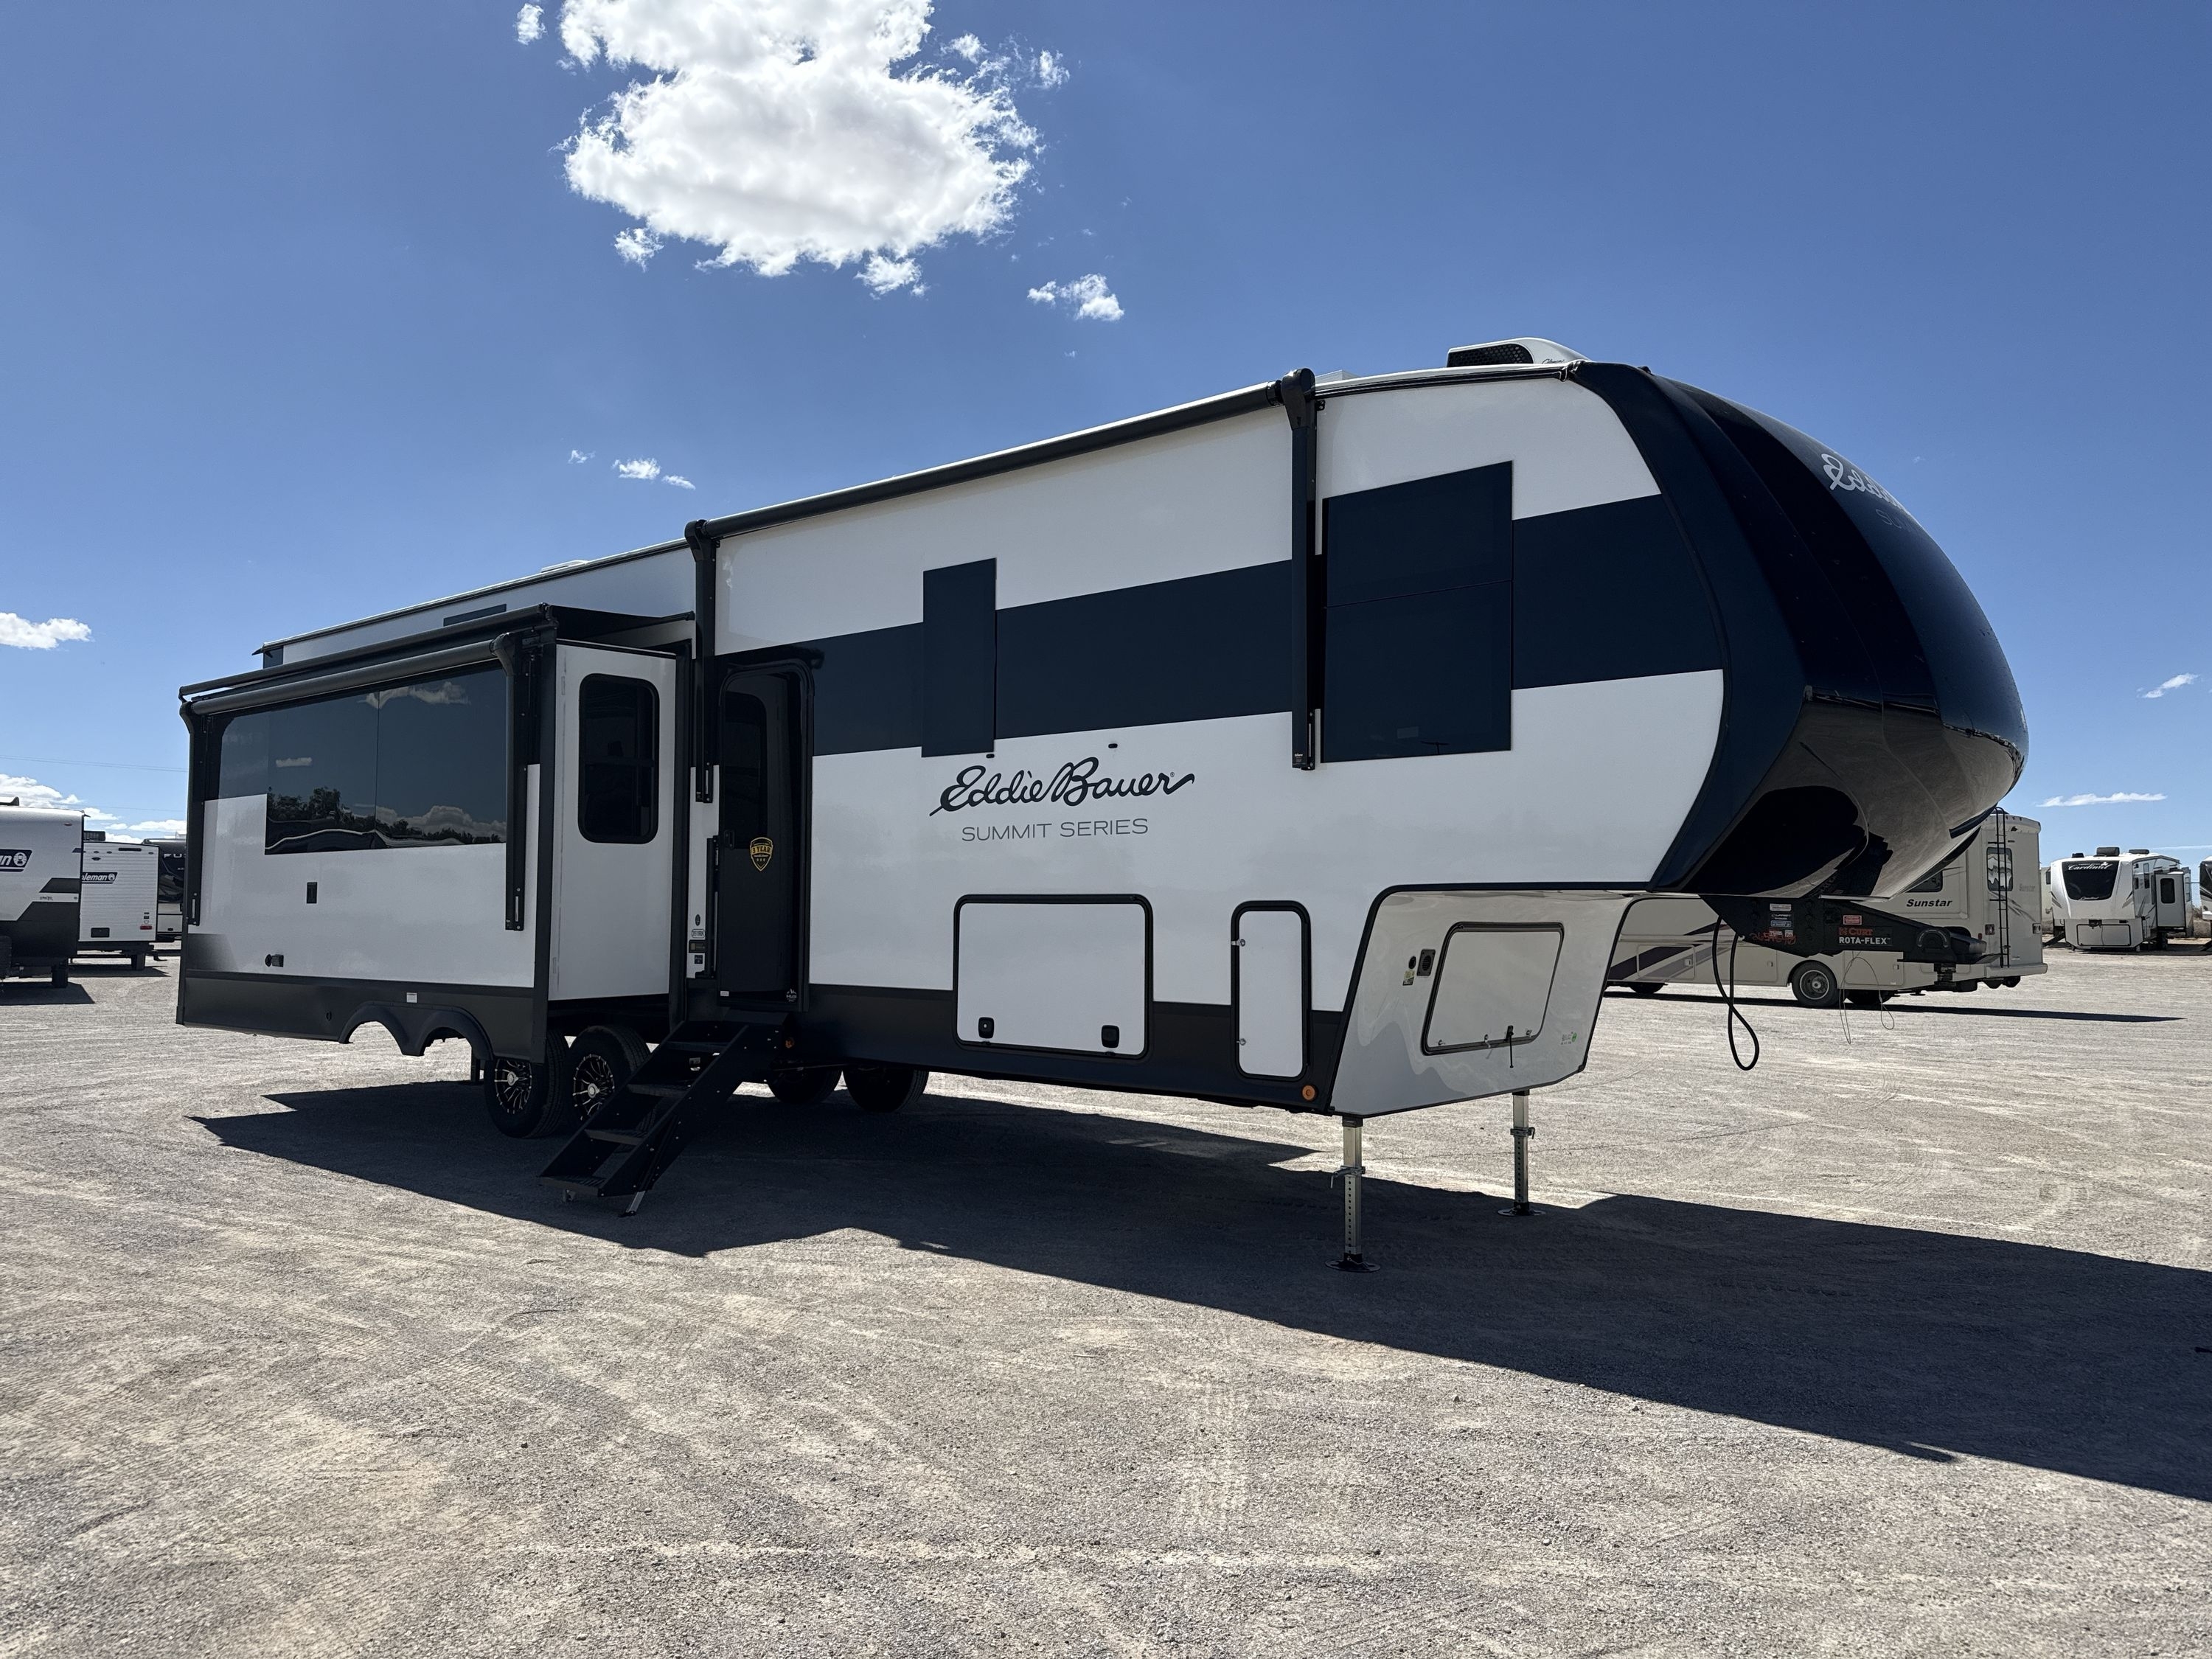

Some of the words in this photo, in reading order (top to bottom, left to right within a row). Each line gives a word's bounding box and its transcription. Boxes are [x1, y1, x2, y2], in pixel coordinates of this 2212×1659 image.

[929, 765, 1044, 816] Eddie
[1048, 757, 1195, 807] Bauer
[961, 823, 1052, 841] SUMMIT
[1060, 818, 1149, 838] SERIES
[1906, 898, 1952, 907] Sunstar
[1839, 936, 1888, 945] ROTA-FLEX
